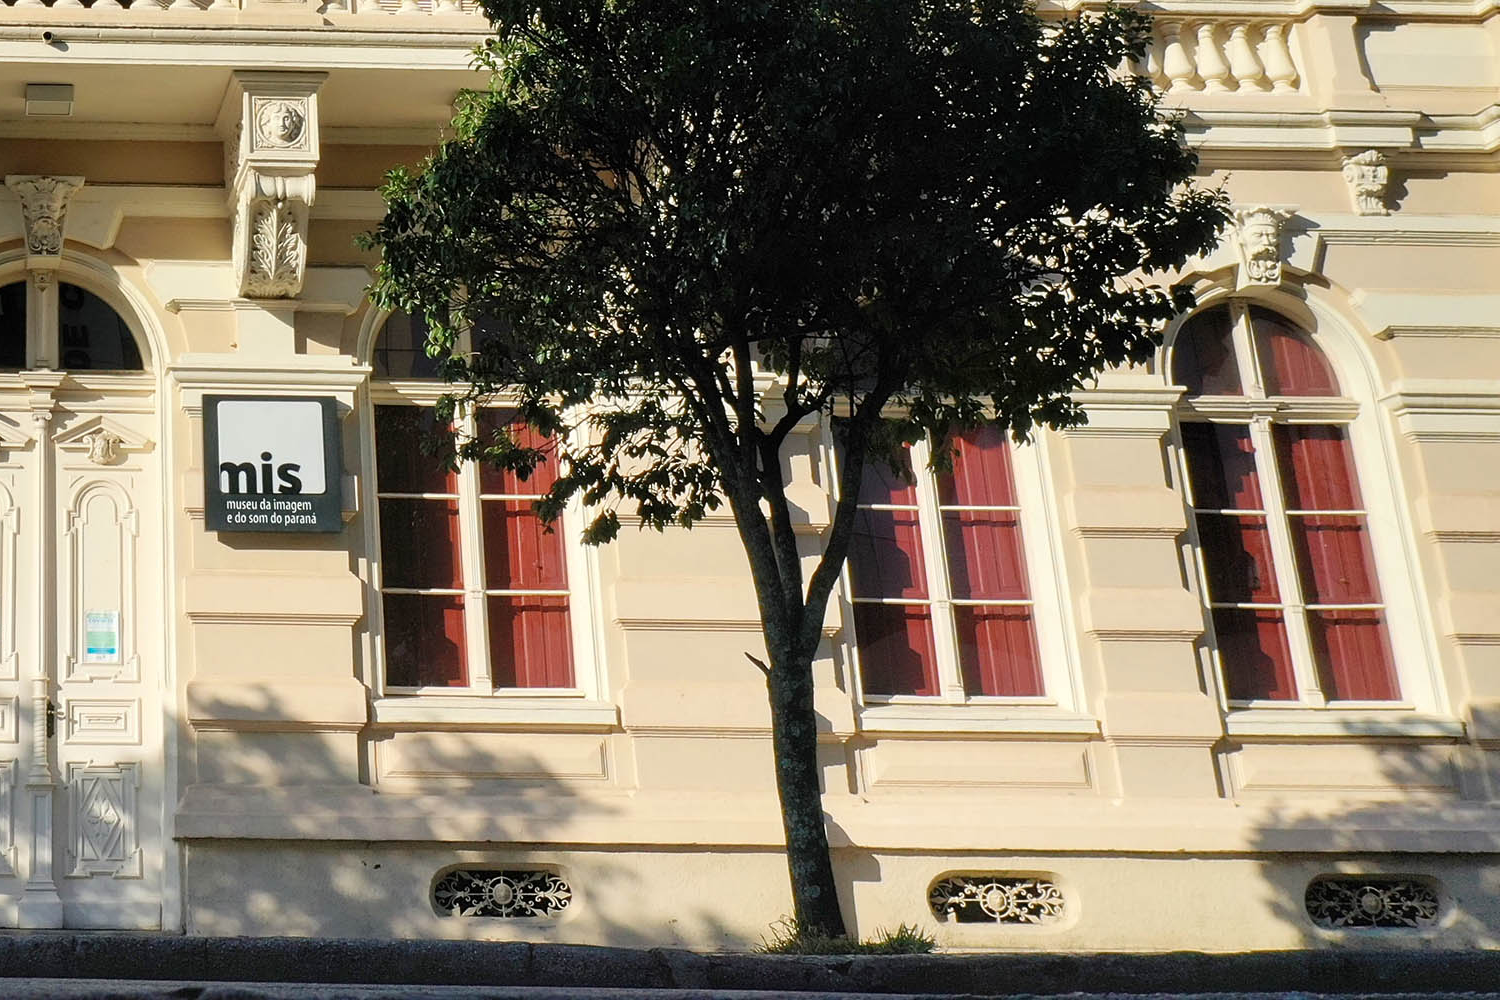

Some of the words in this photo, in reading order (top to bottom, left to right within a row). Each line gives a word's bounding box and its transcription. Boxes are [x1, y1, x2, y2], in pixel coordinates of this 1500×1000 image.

[220, 451, 303, 495] mis
[226, 500, 258, 510] museu
[259, 498, 271, 510] da
[273, 499, 312, 513] imagem
[226, 514, 233, 524] e
[234, 512, 247, 524] do
[248, 514, 268, 524] som
[270, 512, 283, 525] do
[284, 513, 317, 527] paraná
